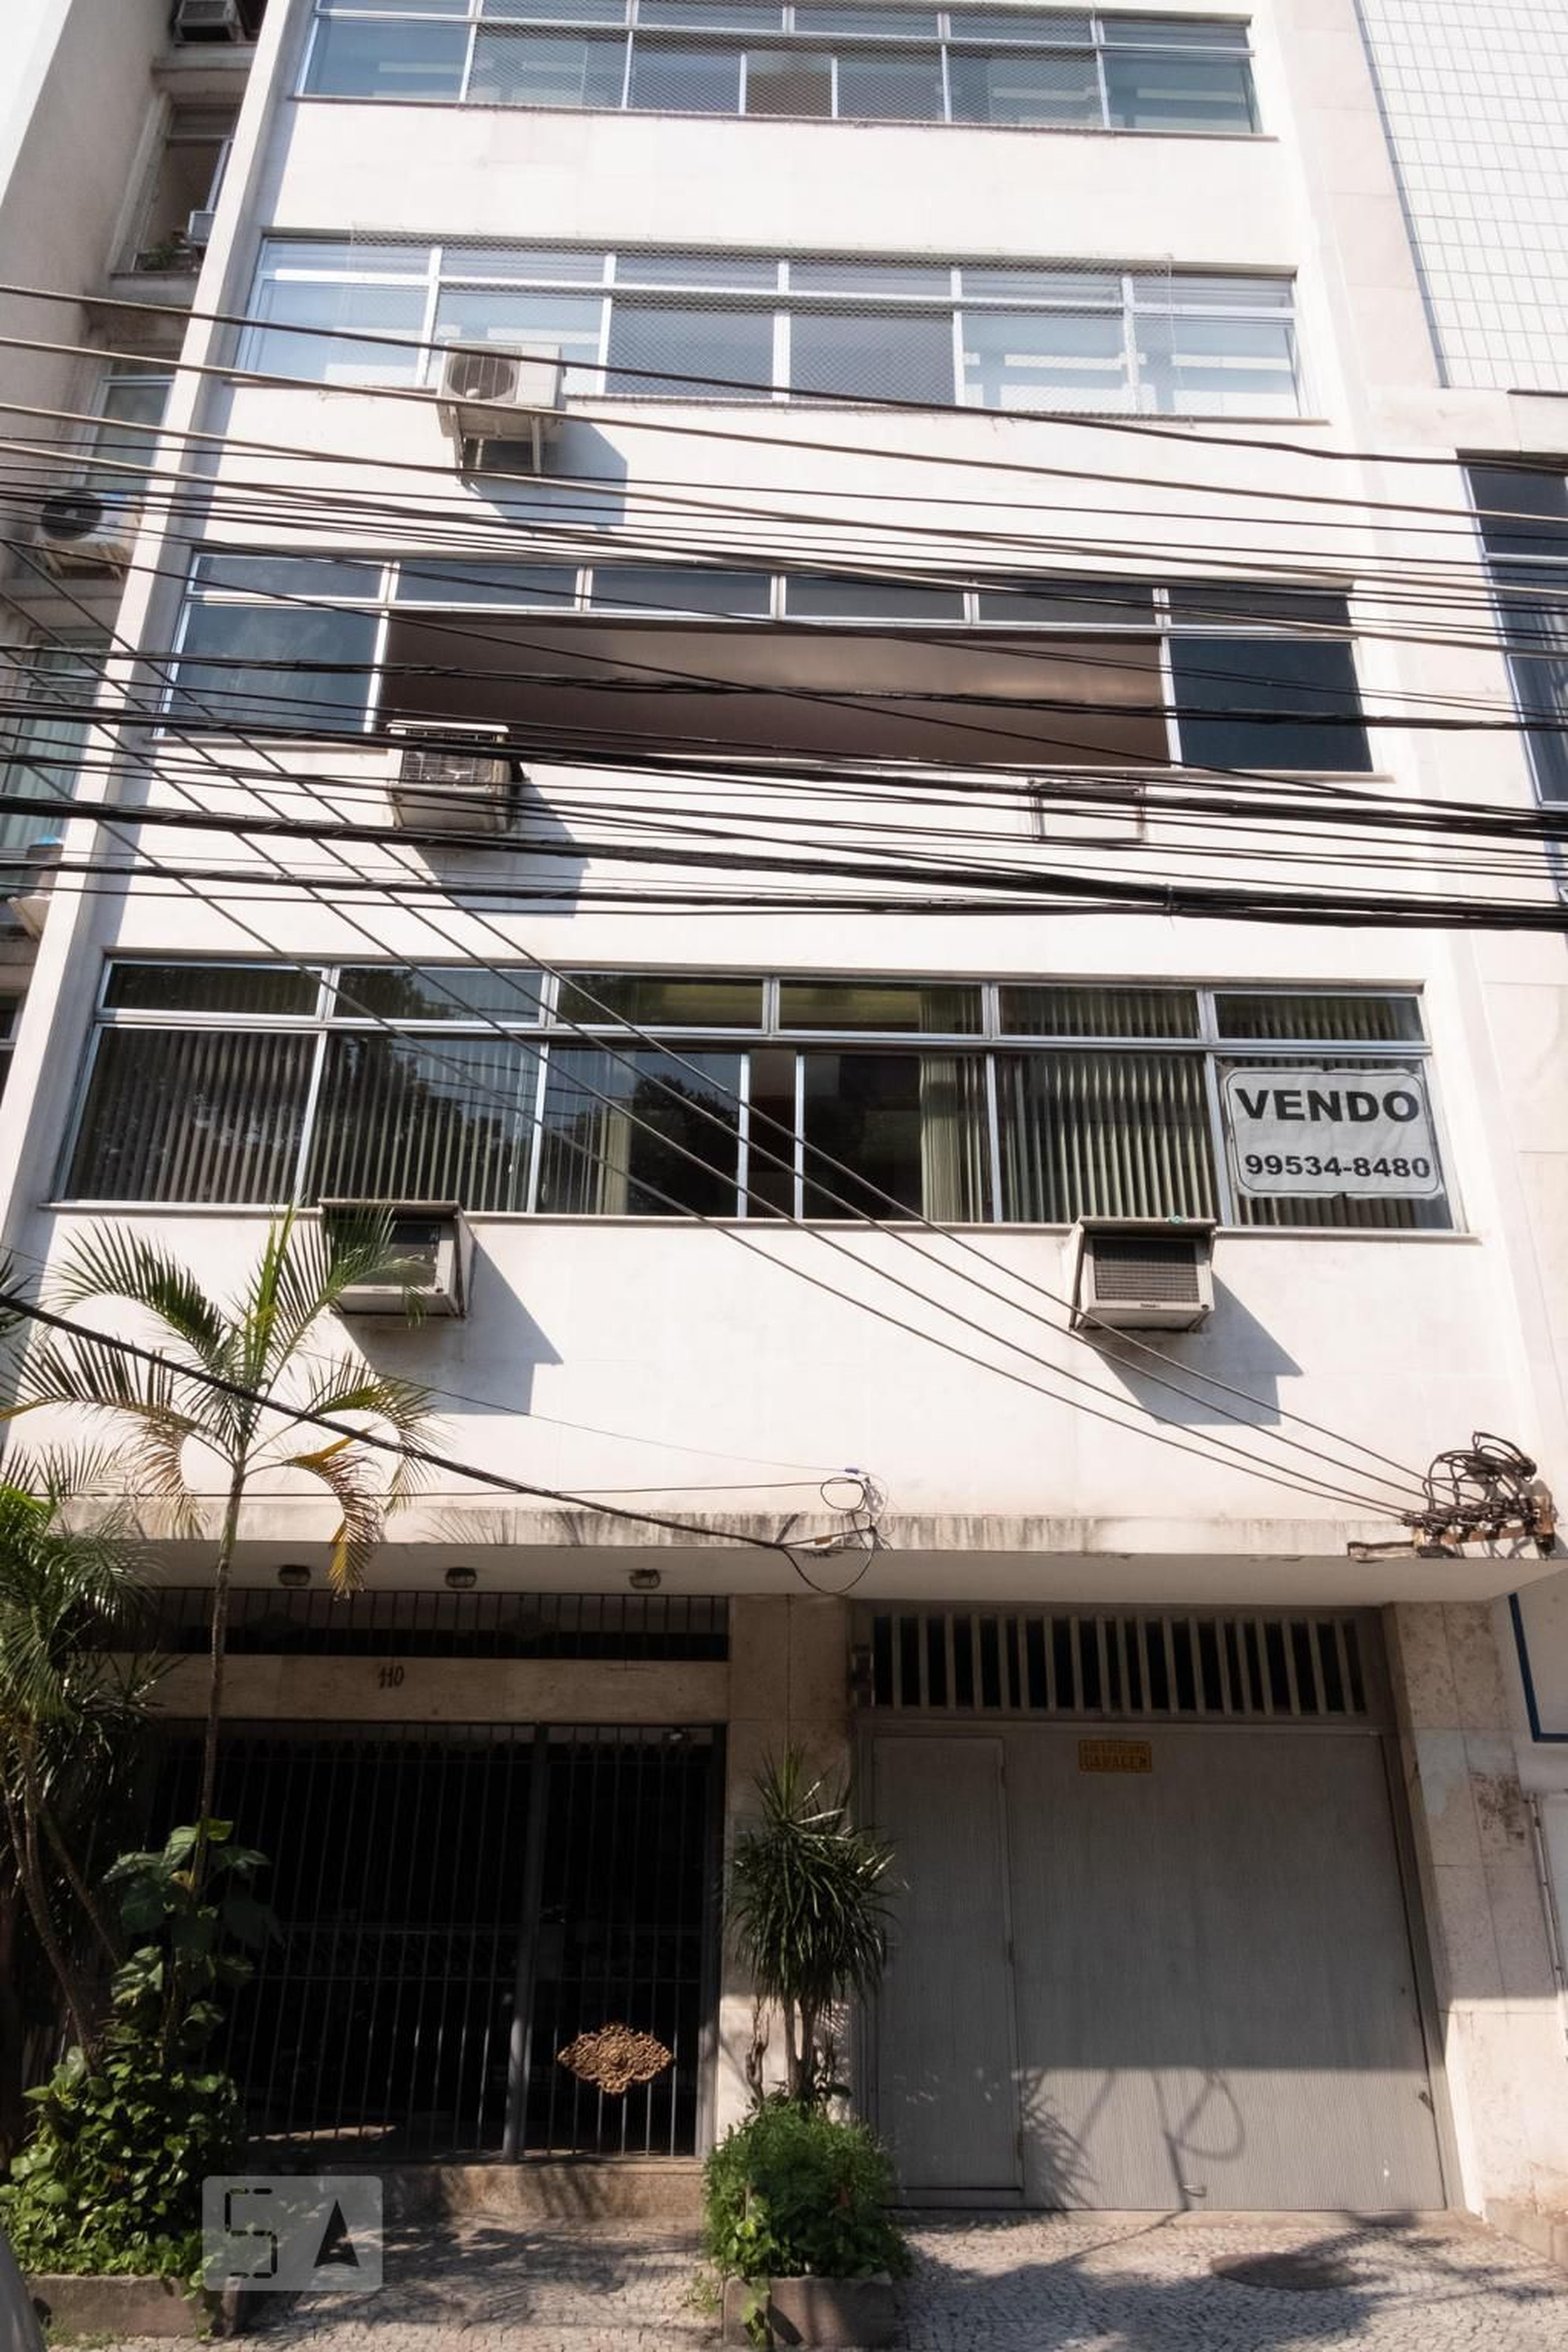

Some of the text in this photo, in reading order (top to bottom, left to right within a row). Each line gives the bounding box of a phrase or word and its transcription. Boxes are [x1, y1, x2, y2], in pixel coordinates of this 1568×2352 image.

[1234, 1088, 1419, 1122] VENDO
[1245, 1154, 1430, 1178] 99534-8480
[377, 1666, 405, 1690] 110
